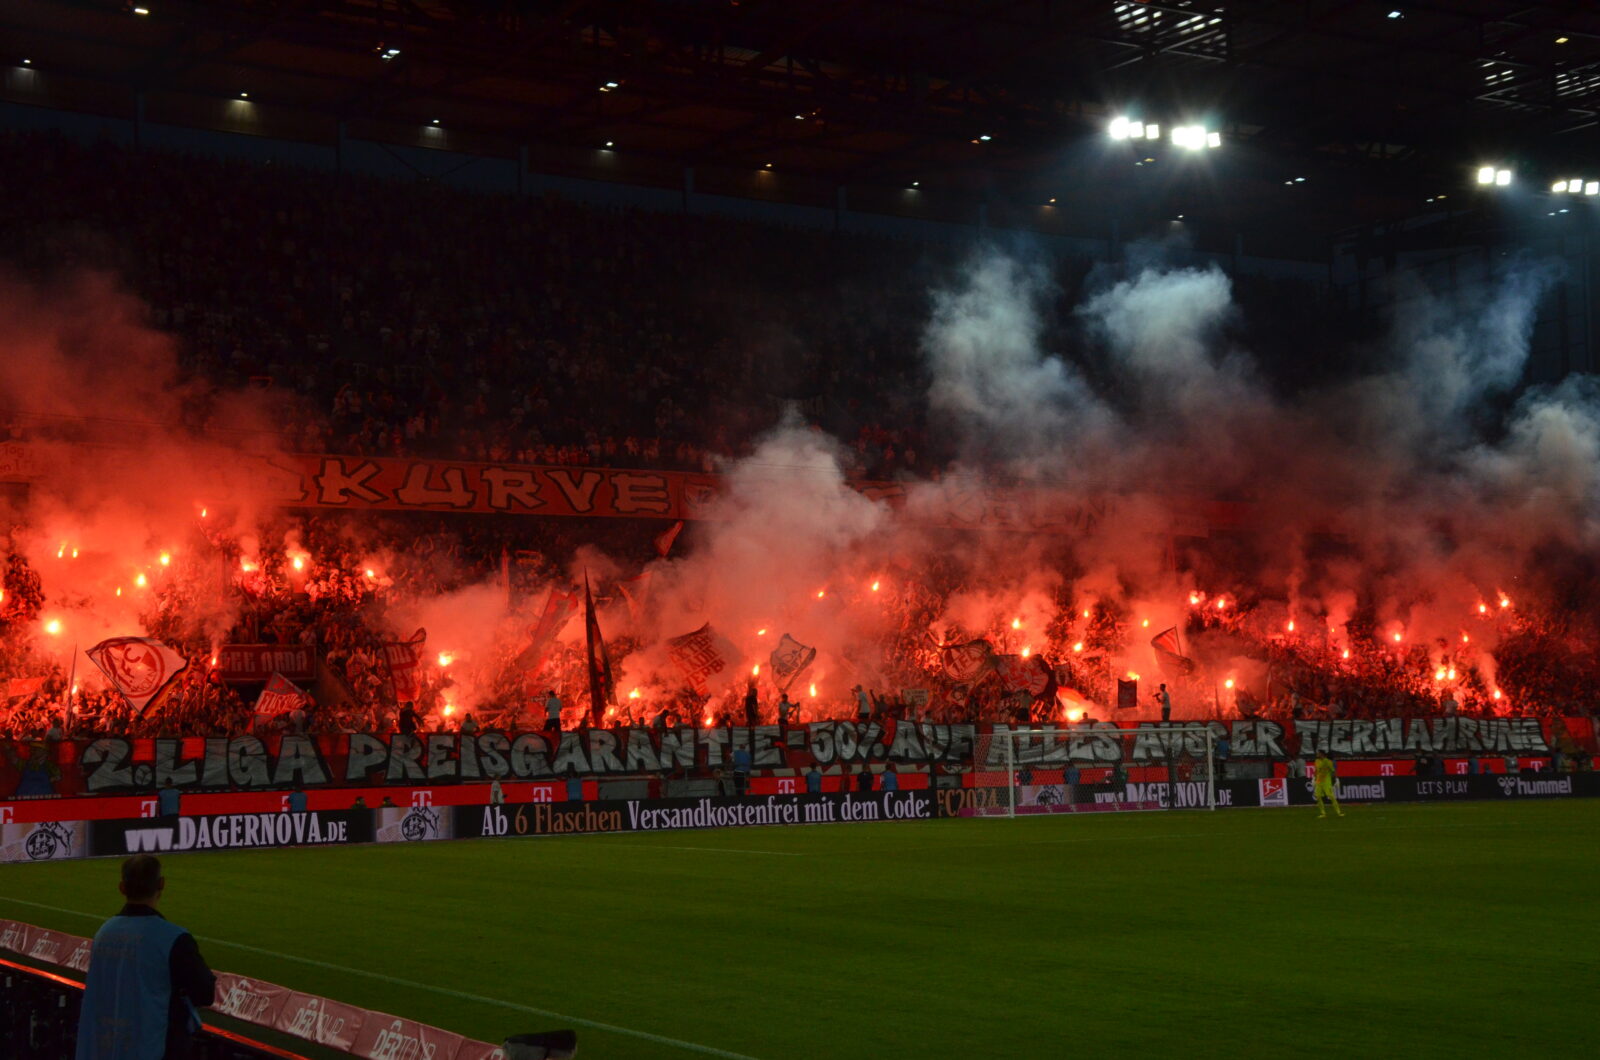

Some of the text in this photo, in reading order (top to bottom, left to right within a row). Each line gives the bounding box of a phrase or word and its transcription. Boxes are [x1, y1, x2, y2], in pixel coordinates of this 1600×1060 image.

[345, 725, 783, 780] PREISGARANTIE
[987, 721, 1122, 765] ALLES
[1336, 779, 1385, 800] ummel
[1416, 780, 1469, 795] LET'S PLAY
[1516, 775, 1573, 795] hummel
[481, 805, 508, 836] Ab
[514, 805, 528, 835] 6
[534, 803, 623, 834] Flaschen
[627, 796, 800, 831] Versandkostenfrei
[804, 796, 836, 822] mit
[840, 794, 879, 821] dem
[883, 791, 931, 820] Code:
